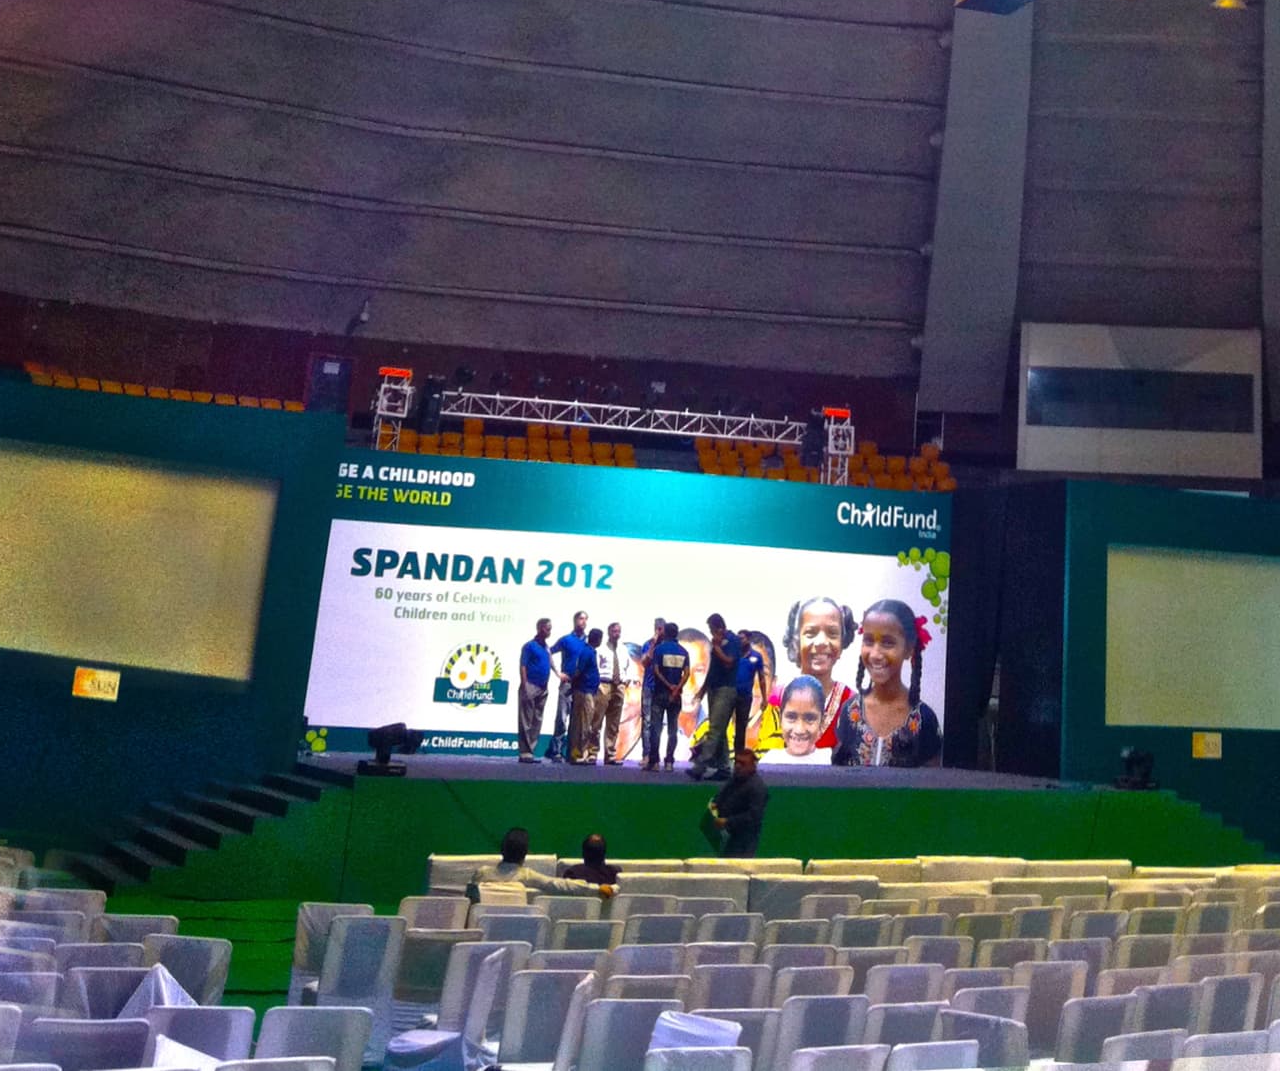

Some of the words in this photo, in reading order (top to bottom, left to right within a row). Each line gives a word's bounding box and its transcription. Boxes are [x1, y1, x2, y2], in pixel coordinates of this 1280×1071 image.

[362, 465, 374, 480] A
[378, 466, 476, 487] CHILDHOOD
[358, 485, 388, 502] THE
[393, 488, 452, 506] WORLD
[350, 547, 525, 585] SPANDAN
[535, 560, 615, 590] 2012
[374, 588, 394, 600] 60
[396, 590, 433, 603] years
[436, 591, 449, 602] of
[393, 606, 448, 621] Children
[451, 610, 475, 622] and
